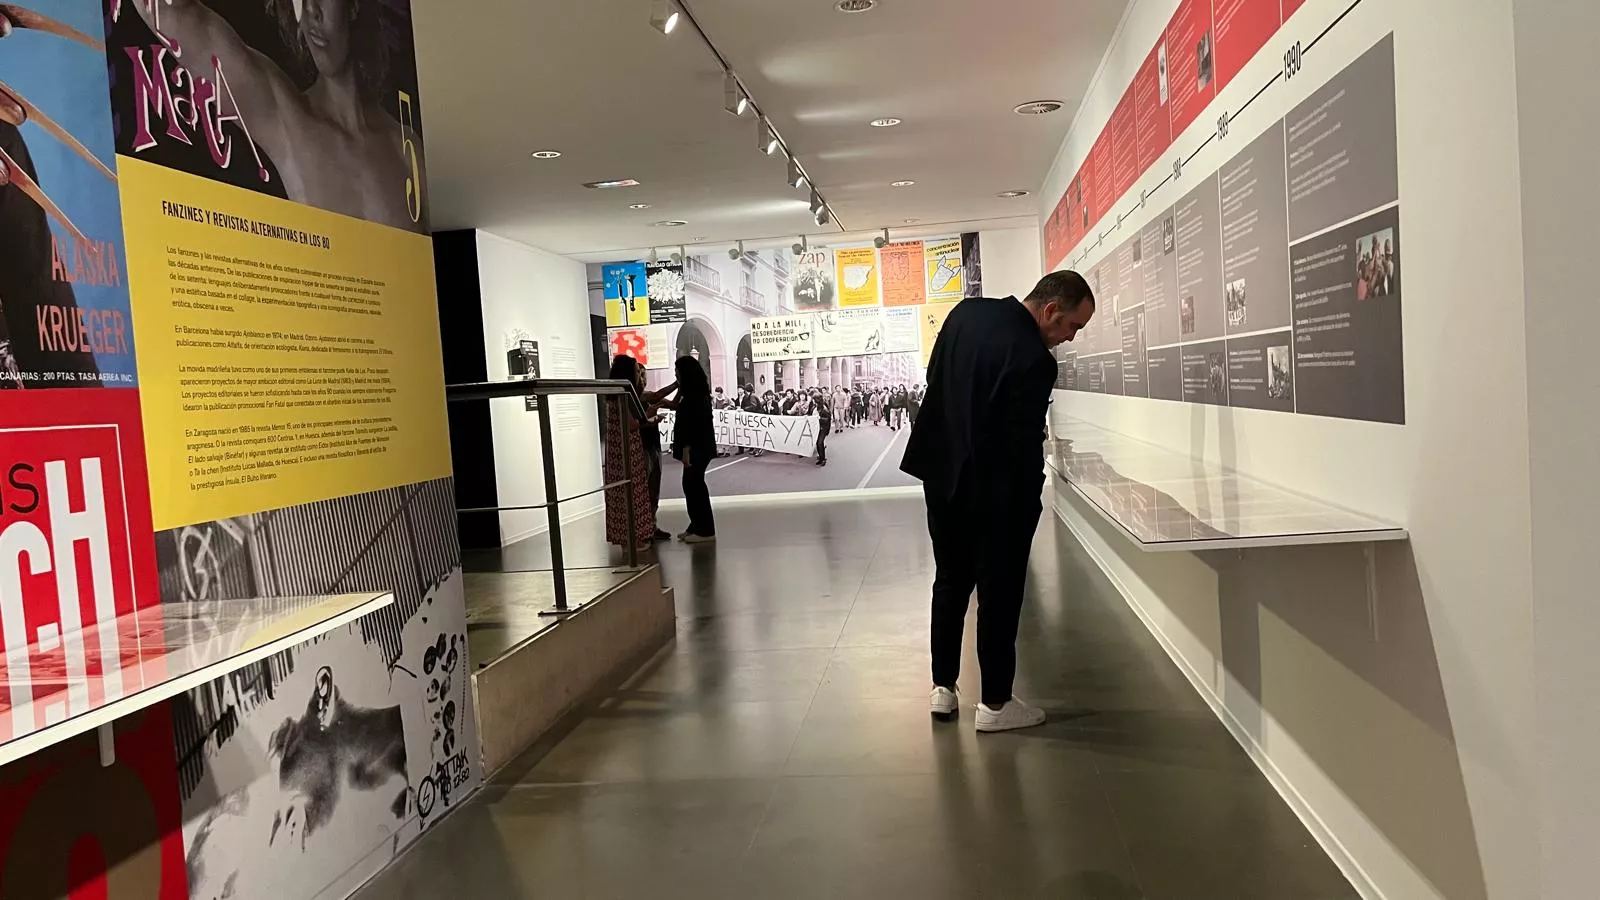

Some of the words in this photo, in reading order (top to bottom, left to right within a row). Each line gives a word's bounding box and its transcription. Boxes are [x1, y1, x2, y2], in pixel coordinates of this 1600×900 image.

[1284, 41, 1301, 82] 1990
[1217, 112, 1228, 141] 1989
[398, 90, 420, 222] 5
[163, 201, 203, 223] FANZINES
[206, 210, 210, 224] Y
[213, 212, 248, 232] REVISTAS
[251, 220, 298, 242] ALTERNATIVAS
[300, 232, 308, 244] EN
[310, 235, 320, 247] LOS
[322, 236, 330, 249] 80
[52, 232, 120, 286] ALASKA
[167, 245, 176, 254] Los
[178, 248, 199, 258] fanzines
[213, 255, 231, 263] revistas
[800, 251, 826, 268] zap
[177, 260, 199, 270] décadas
[208, 290, 225, 298] basada
[193, 302, 214, 310] obscena
[36, 304, 128, 355] KRUEGER
[183, 326, 209, 334] Barcelona
[176, 339, 212, 348] publicaciones
[0, 372, 42, 380] CANARIAS:
[43, 372, 56, 381] 200
[79, 373, 97, 381] TASA
[98, 373, 120, 382] AEREA
[210, 402, 236, 411] publicación
[720, 412, 729, 424] DE
[734, 414, 776, 429] HUESCA
[194, 428, 217, 438] Zaragoza
[779, 420, 814, 447] YA
[207, 454, 223, 462] salvaje
[207, 466, 219, 475] chen
[242, 462, 256, 470] Lucas
[197, 480, 224, 490] prestigiosa
